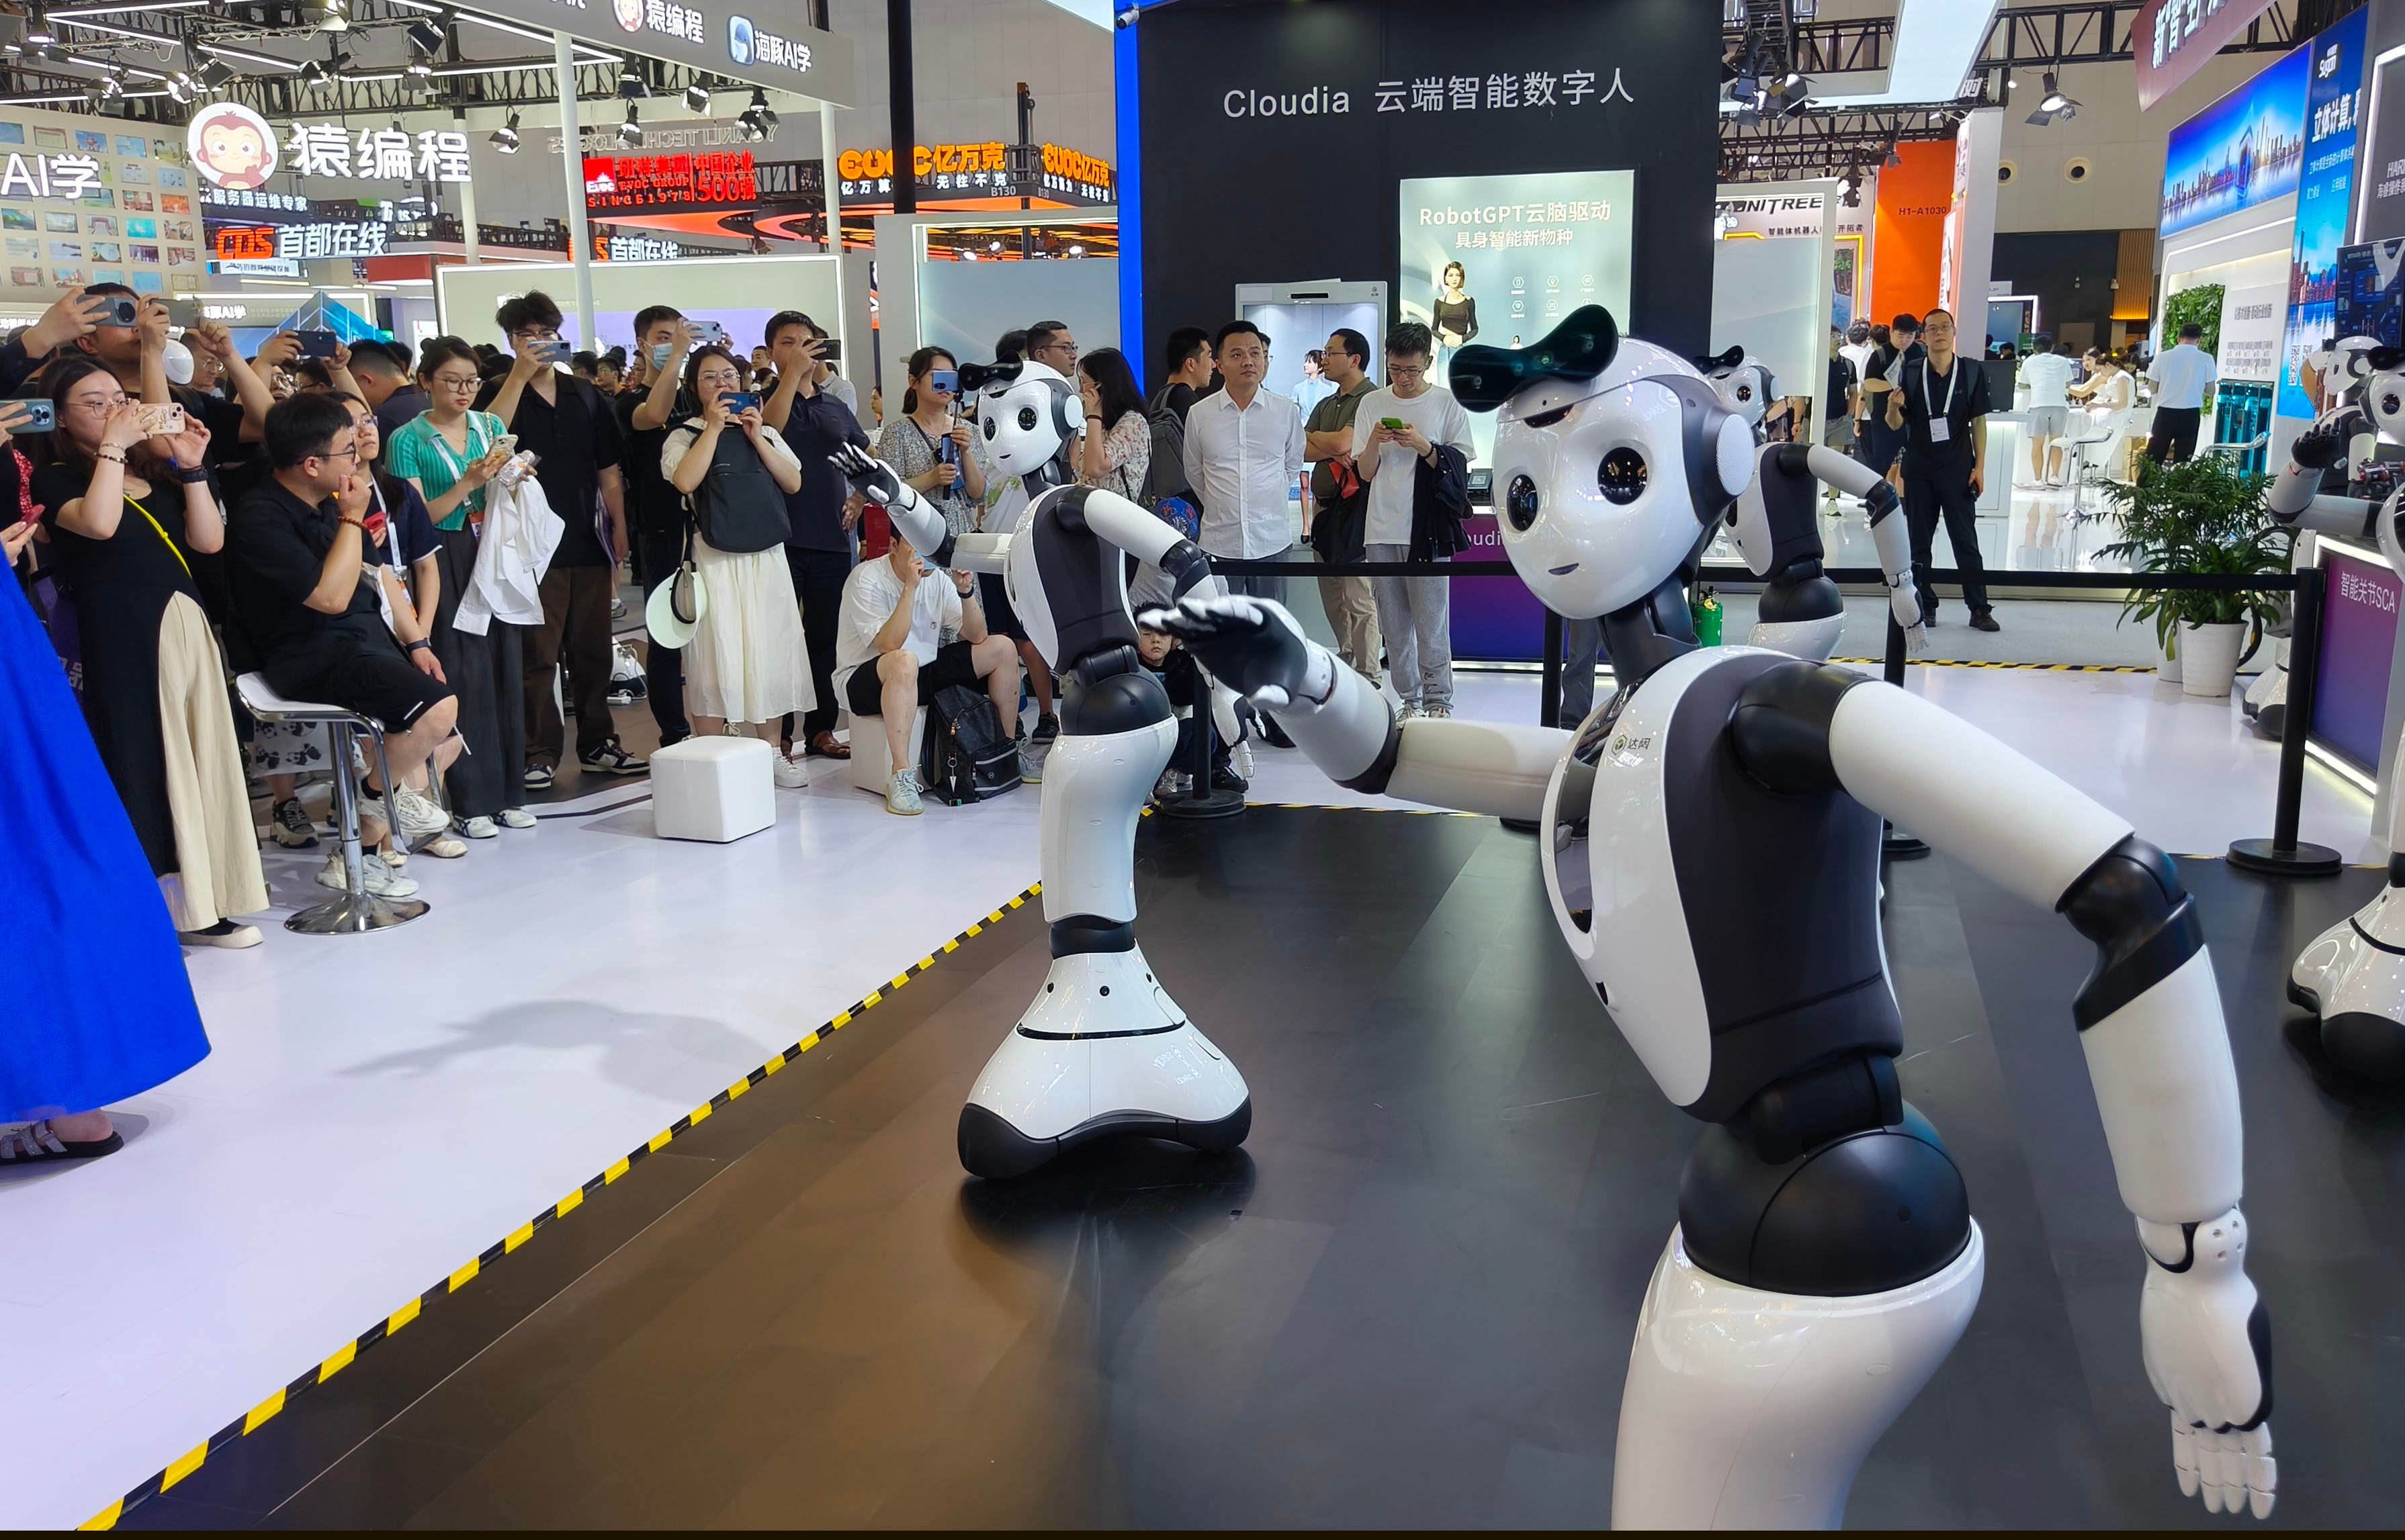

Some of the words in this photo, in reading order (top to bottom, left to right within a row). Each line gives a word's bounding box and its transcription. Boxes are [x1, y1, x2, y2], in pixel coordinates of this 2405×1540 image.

[646, 0, 704, 44] 猿编程
[754, 30, 812, 72] 海豚AI学
[1223, 87, 1350, 118] Cloudia
[1374, 68, 1634, 114] 云端智能数字人
[287, 123, 472, 183] 猿编程
[695, 150, 755, 176] 中国企业
[1, 154, 102, 199] AI学
[618, 179, 650, 191] EVOC
[652, 177, 689, 188] GROUP
[697, 176, 756, 202] 500强
[840, 179, 892, 195] 亿万算
[936, 173, 1007, 189] 无往不克
[991, 186, 1016, 197] B130
[1038, 189, 1049, 198] B130
[1419, 200, 1611, 225] RobotGPT云脑驱动
[1898, 206, 1947, 215] H1-A1030
[279, 222, 387, 257] 首都在线
[609, 236, 679, 260] 首都在线
[1455, 228, 1574, 249] 具身智能新物种
[2341, 570, 2396, 613] 智能关节SCA
